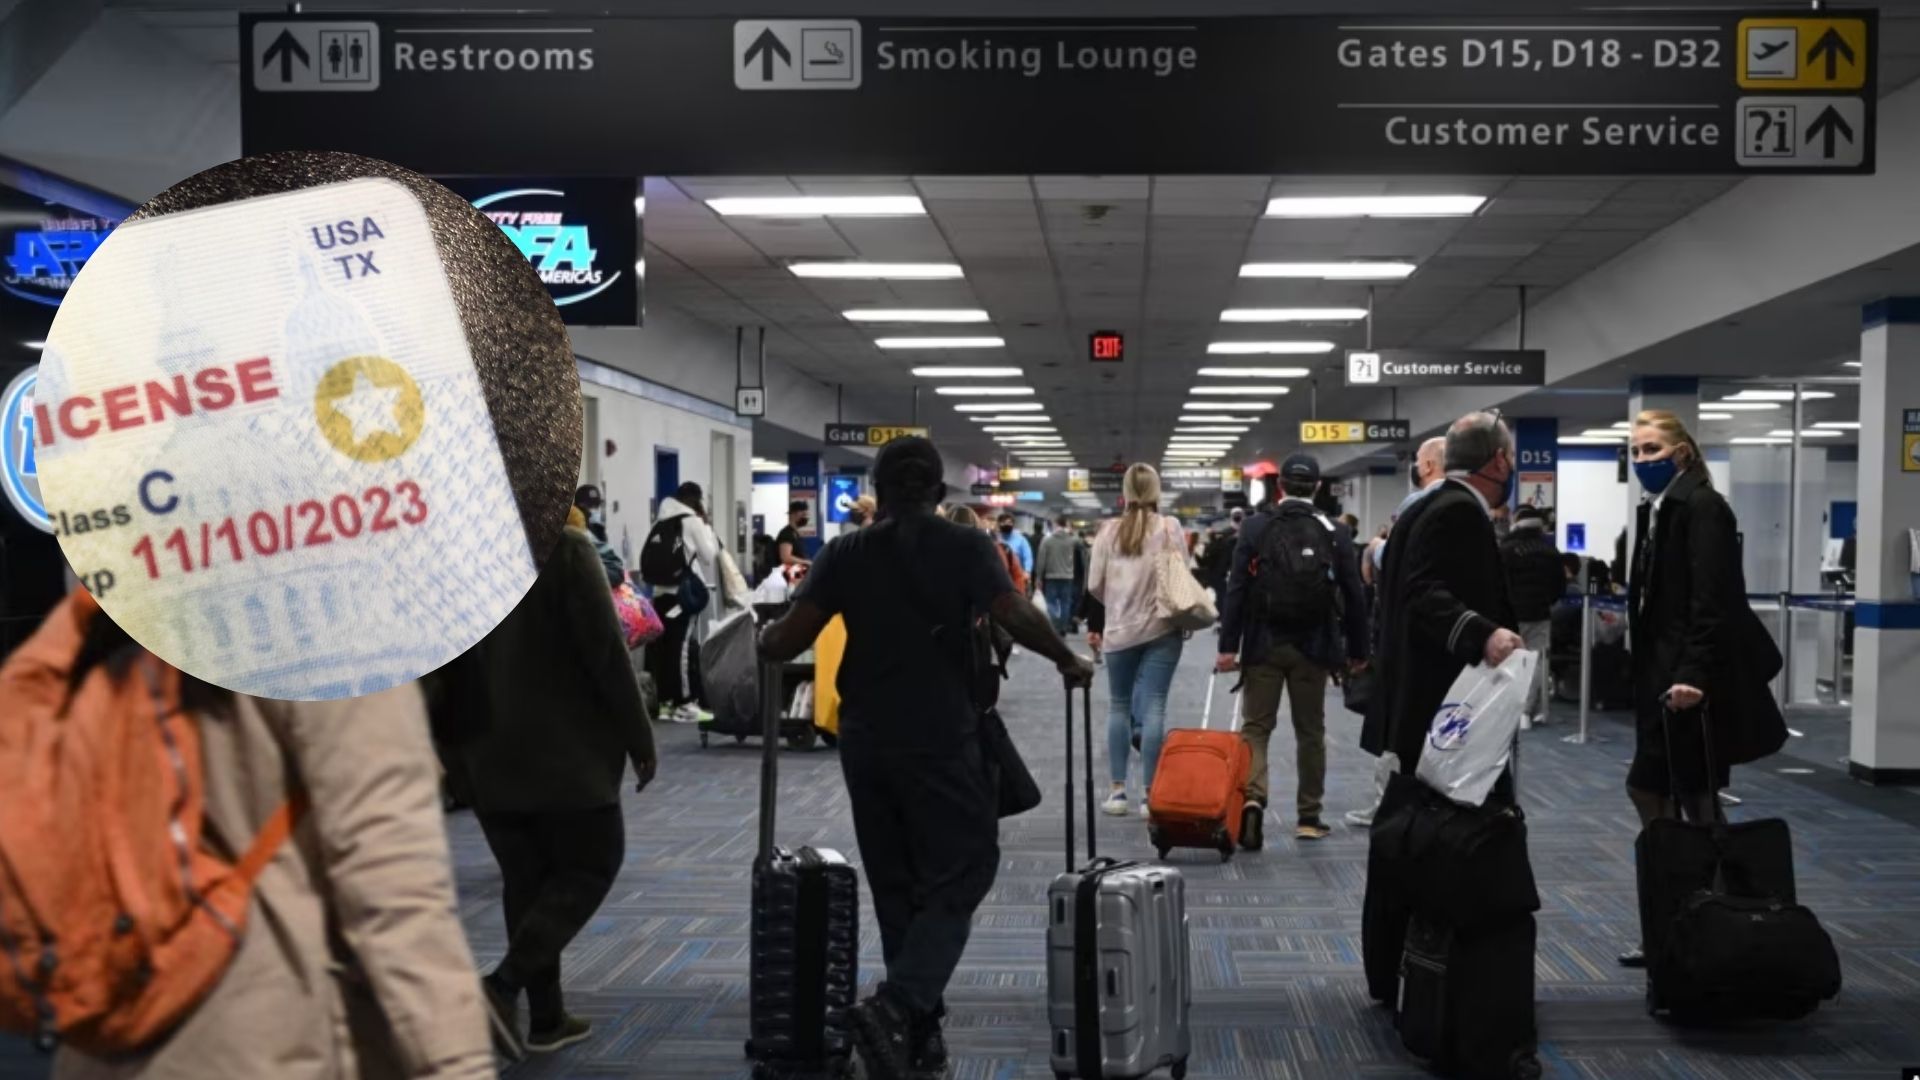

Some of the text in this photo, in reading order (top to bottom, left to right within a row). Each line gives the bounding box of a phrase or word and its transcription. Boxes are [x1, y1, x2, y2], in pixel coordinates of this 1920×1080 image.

[394, 42, 595, 72] Restrooms
[877, 41, 1198, 77] Smoking Lounge
[1337, 37, 1448, 70] Gates
[1654, 38, 1721, 69] D32
[1385, 115, 1719, 147] Customer Service
[312, 216, 384, 252] USA
[334, 250, 382, 280] TX
[1094, 337, 1120, 359] EXIT
[1382, 361, 1460, 375] Customer
[1464, 360, 1523, 375] Service
[34, 357, 281, 446] ICENSE
[828, 428, 865, 442] Gate
[1367, 424, 1406, 439] Gate
[1520, 450, 1552, 465] D15
[139, 469, 180, 516] C
[130, 480, 430, 581] 11/10/2023
